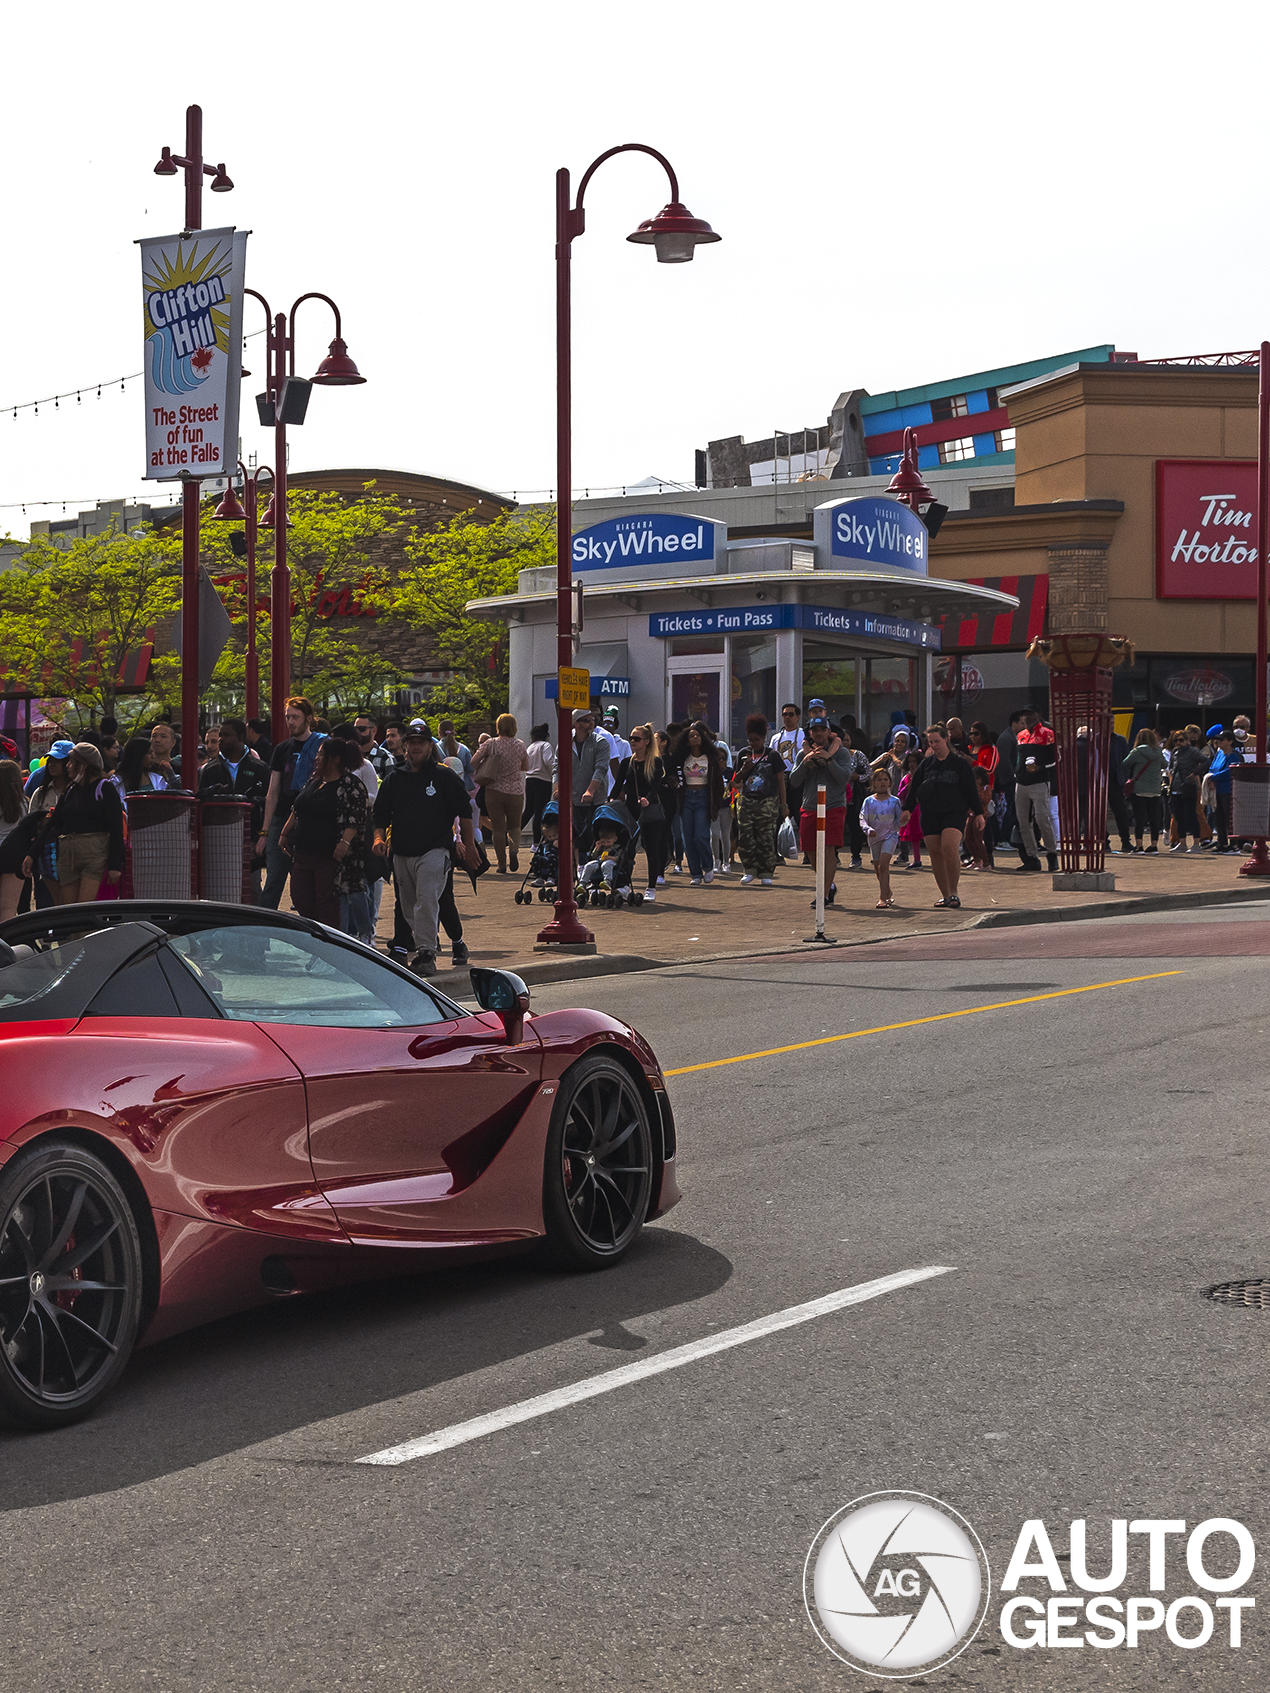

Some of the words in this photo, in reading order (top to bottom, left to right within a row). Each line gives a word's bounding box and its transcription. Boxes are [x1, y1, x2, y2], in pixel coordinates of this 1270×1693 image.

[148, 276, 224, 327] Clifton
[171, 313, 216, 357] Hill
[153, 407, 176, 426] The
[179, 403, 219, 424] Street
[167, 425, 180, 445] of
[182, 426, 204, 443] fun
[151, 449, 164, 466] at
[167, 446, 188, 465] the
[191, 443, 220, 463] Falls
[1199, 494, 1253, 528] Tim
[615, 520, 653, 531] NIAGARA
[837, 512, 924, 559] SkyWheel
[572, 525, 704, 563] SkyWheel
[658, 617, 703, 632] Tickets
[718, 614, 740, 628] Fun
[744, 612, 773, 626] Pass
[814, 612, 850, 629] Tickets
[864, 618, 910, 639] Information
[601, 680, 629, 694] ATM
